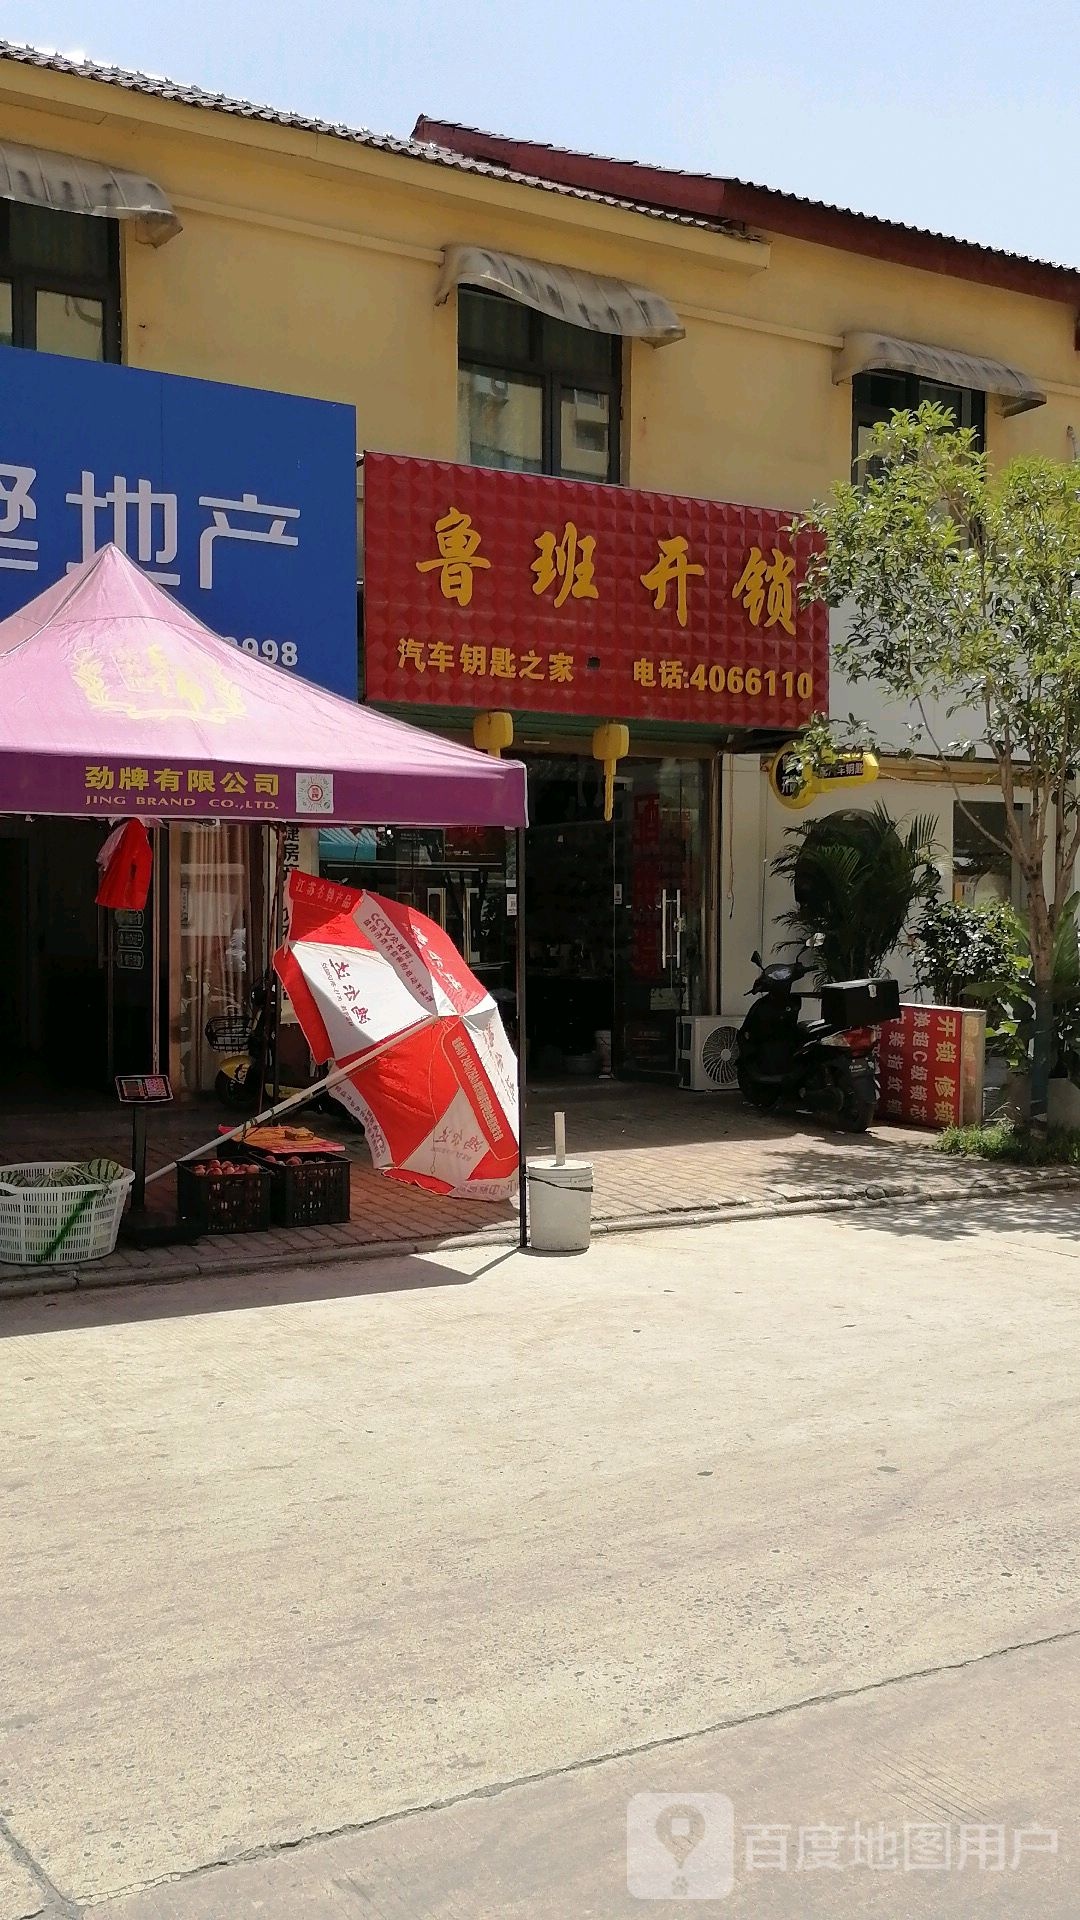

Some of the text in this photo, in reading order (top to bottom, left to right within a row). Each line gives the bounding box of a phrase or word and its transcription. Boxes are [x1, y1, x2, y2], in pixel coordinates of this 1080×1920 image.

[416, 506, 797, 635] 鲁班开锁
[397, 637, 575, 684] 汽车钥匙之家
[632, 657, 814, 700] 电话:4066110
[84, 765, 280, 797] 劲牌有限公司
[85, 795, 126, 806] JING
[136, 797, 196, 807] BRAND
[935, 1014, 957, 1064] 开锁
